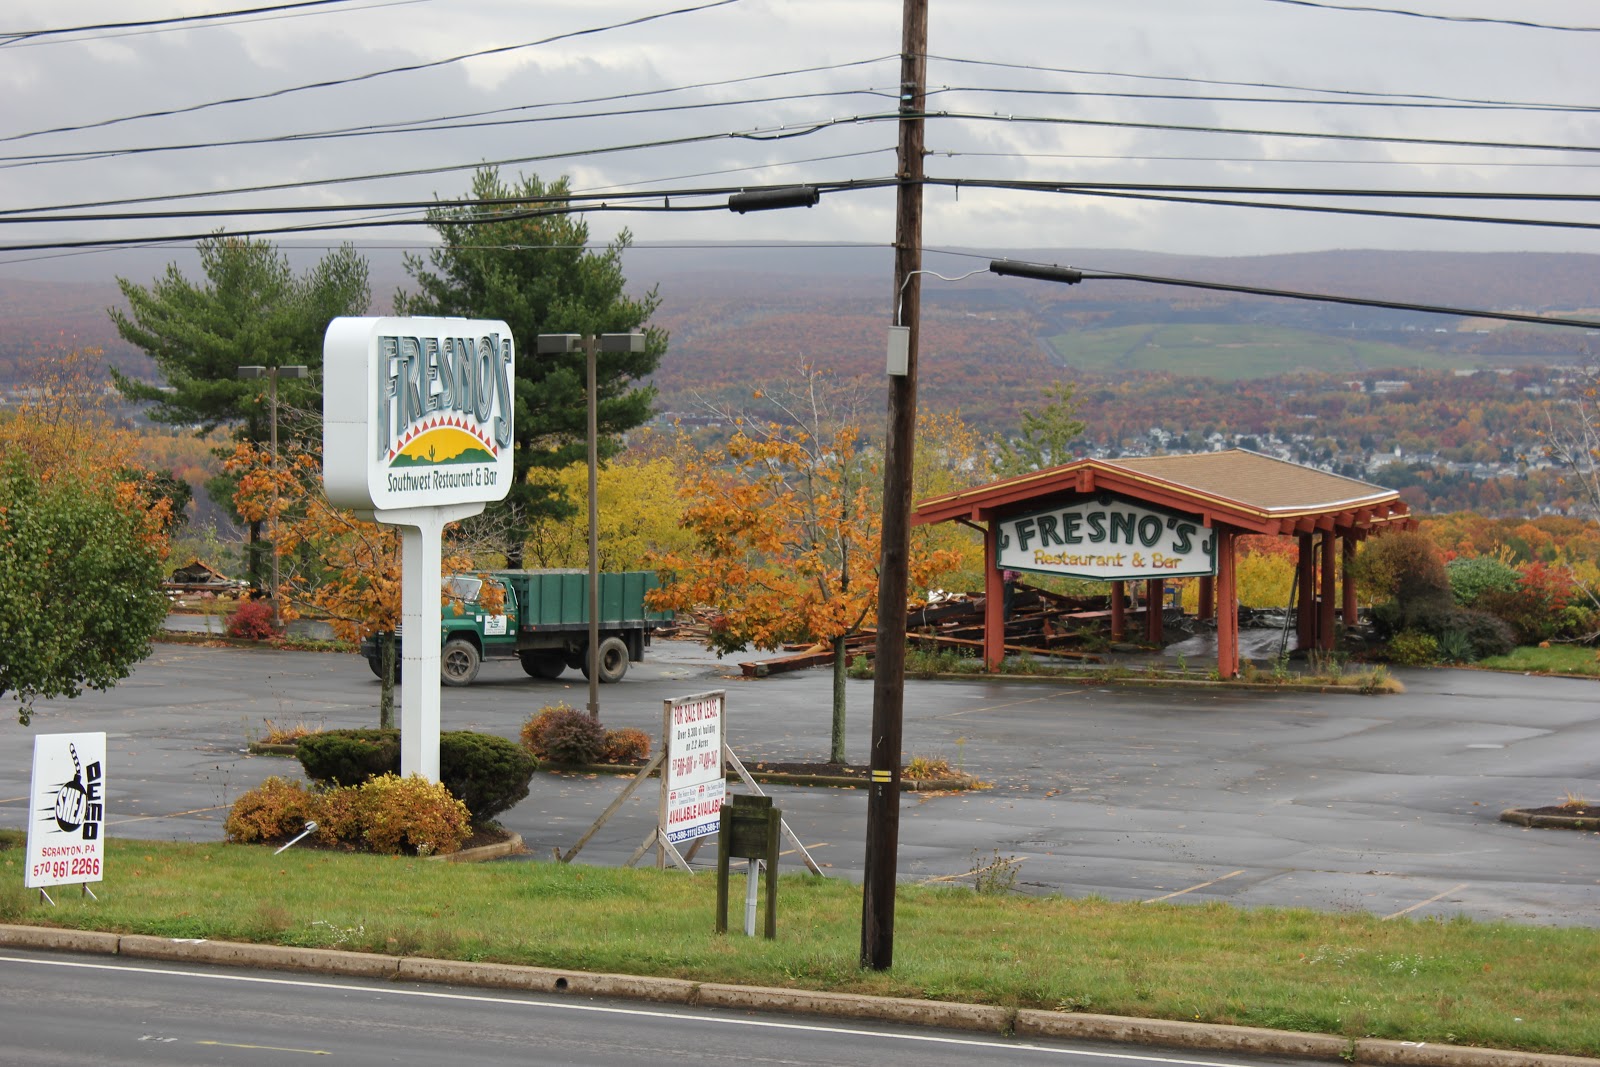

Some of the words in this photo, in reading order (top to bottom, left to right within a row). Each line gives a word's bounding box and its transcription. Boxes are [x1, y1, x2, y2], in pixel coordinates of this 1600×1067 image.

[378, 333, 512, 461] FRESNO'S
[388, 469, 431, 492] Southwest
[433, 468, 474, 490] Restaurant
[475, 467, 481, 486] &
[484, 467, 497, 486] Bar
[1015, 511, 1196, 555] FRESNO'S
[1034, 549, 1126, 567] Restaurant
[1132, 552, 1146, 568] &
[1152, 552, 1183, 569] Bar
[674, 706, 683, 725] FOR
[685, 703, 696, 723] SALE
[704, 699, 718, 719] LEASE
[57, 786, 87, 825] SHEA
[669, 805, 697, 825] AVAILABLE
[42, 845, 84, 857] SCRANTON,
[85, 844, 95, 854] PA
[33, 861, 51, 877] 570
[53, 861, 69, 878] 961
[71, 857, 100, 876] 2266
